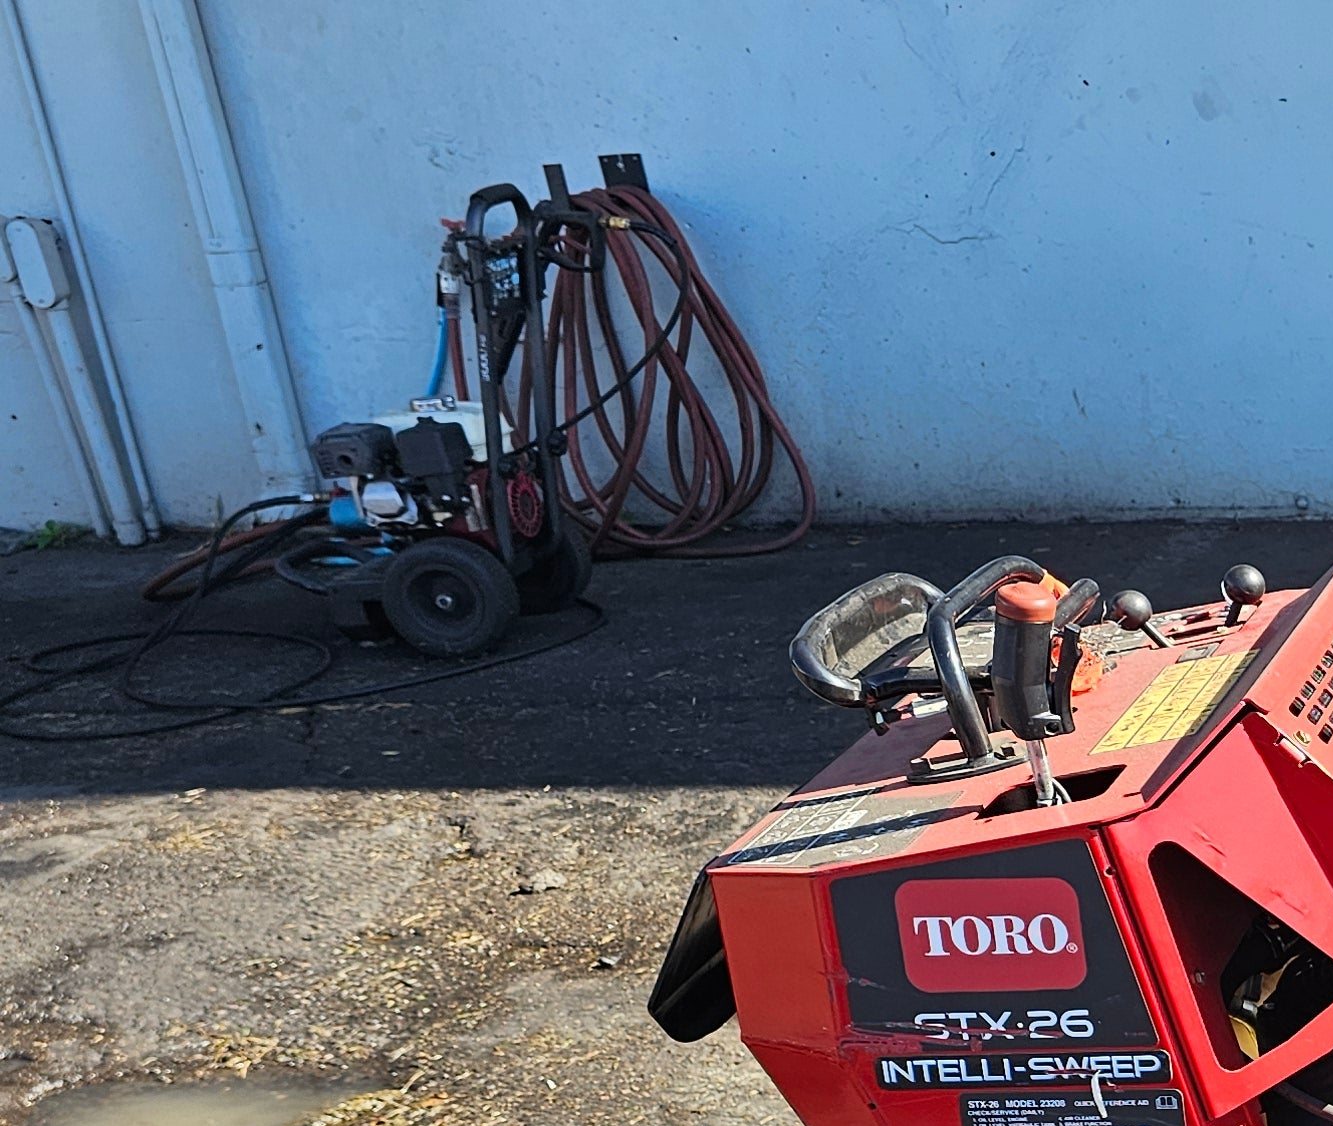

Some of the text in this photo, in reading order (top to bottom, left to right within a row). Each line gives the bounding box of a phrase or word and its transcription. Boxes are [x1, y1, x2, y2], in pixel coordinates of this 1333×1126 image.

[913, 913, 1070, 956] TORO
[880, 1053, 1163, 1085] INTELLI-SWEEP
[967, 1100, 1000, 1109] STX-26
[1005, 1099, 1039, 1108] MODEL
